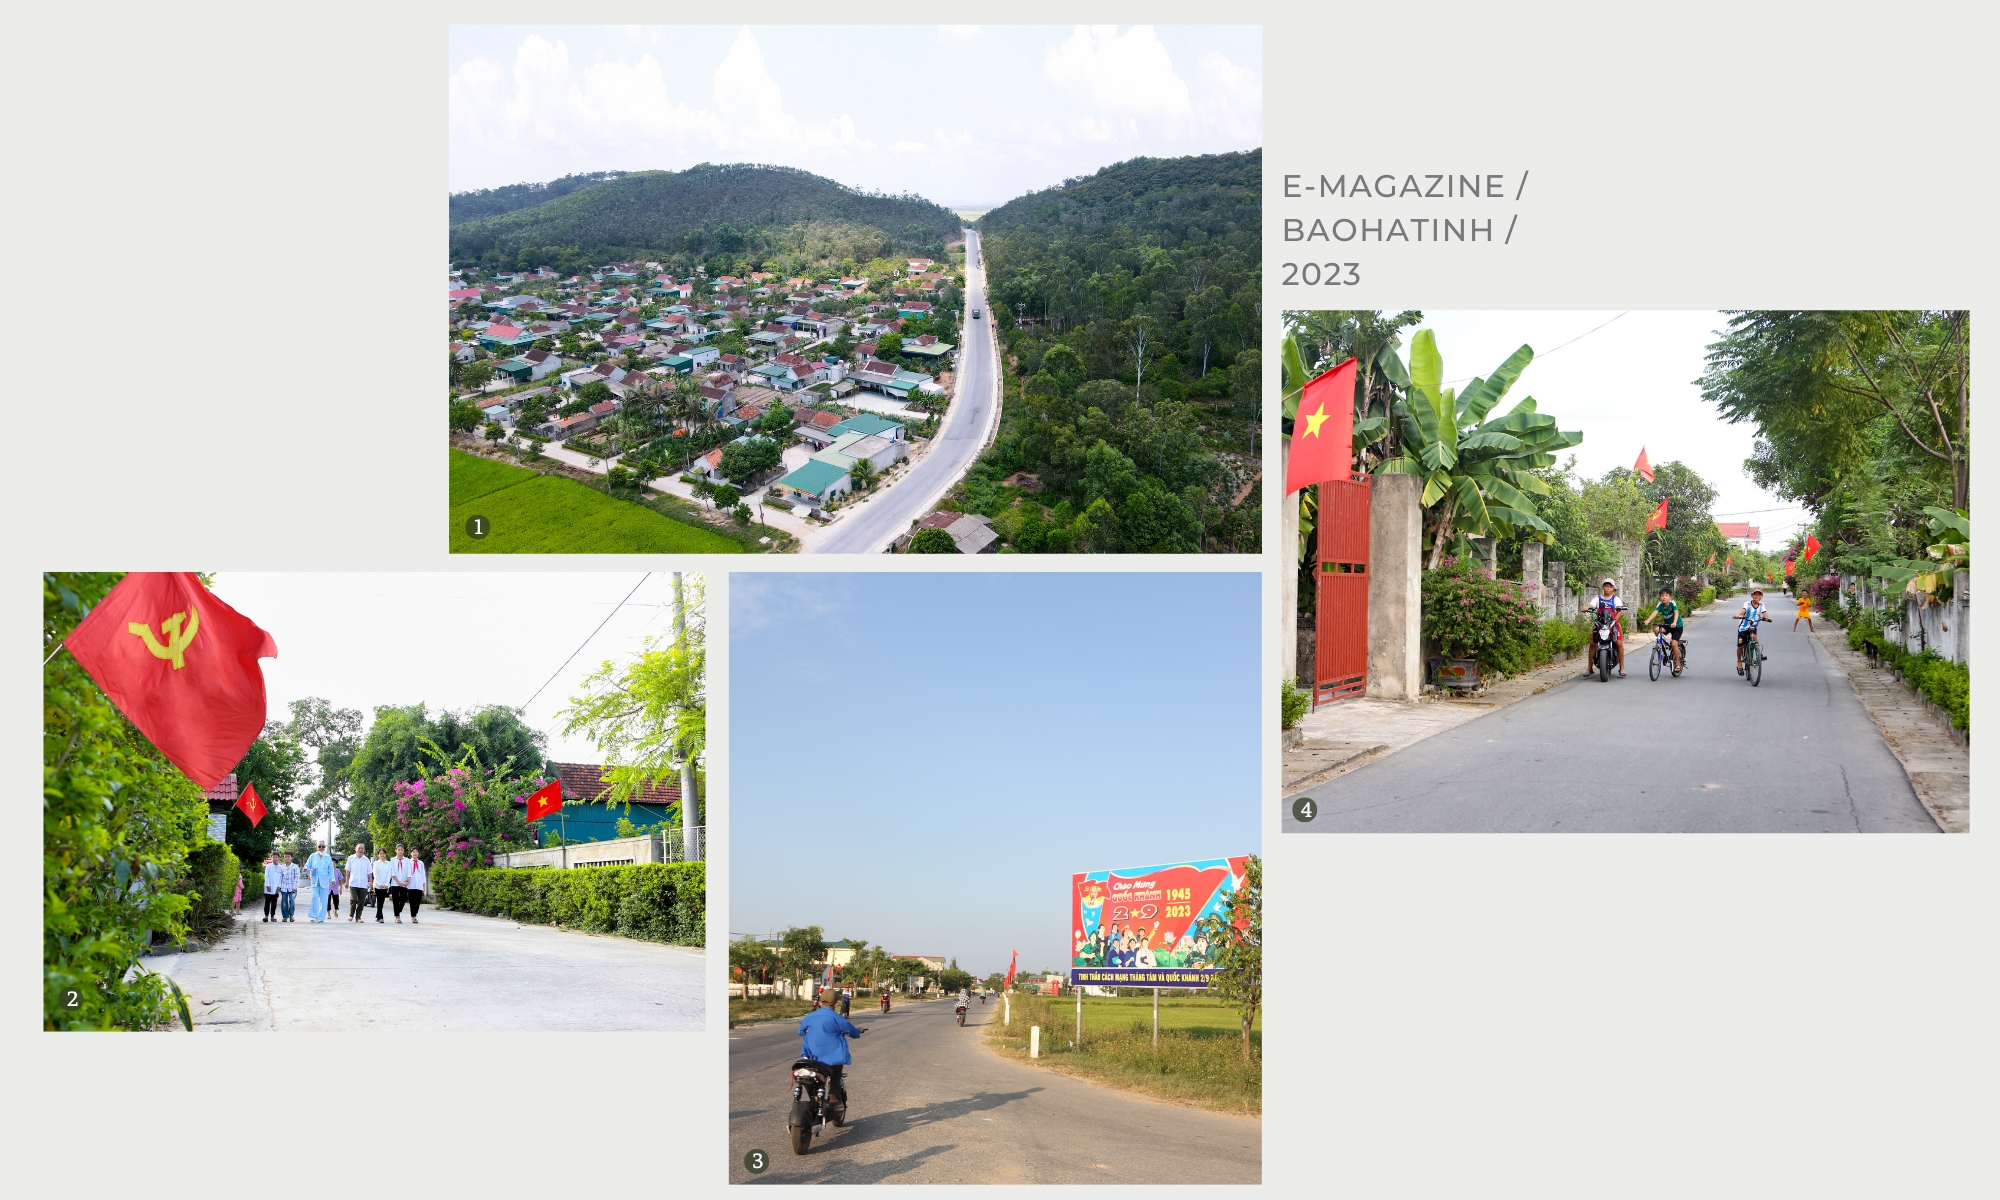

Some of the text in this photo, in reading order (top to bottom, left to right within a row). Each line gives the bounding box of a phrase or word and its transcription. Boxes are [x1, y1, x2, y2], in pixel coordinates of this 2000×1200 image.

[1166, 887, 1191, 901] 1945
[1112, 903, 1158, 920] 2 9
[1165, 904, 1191, 918] 2023
